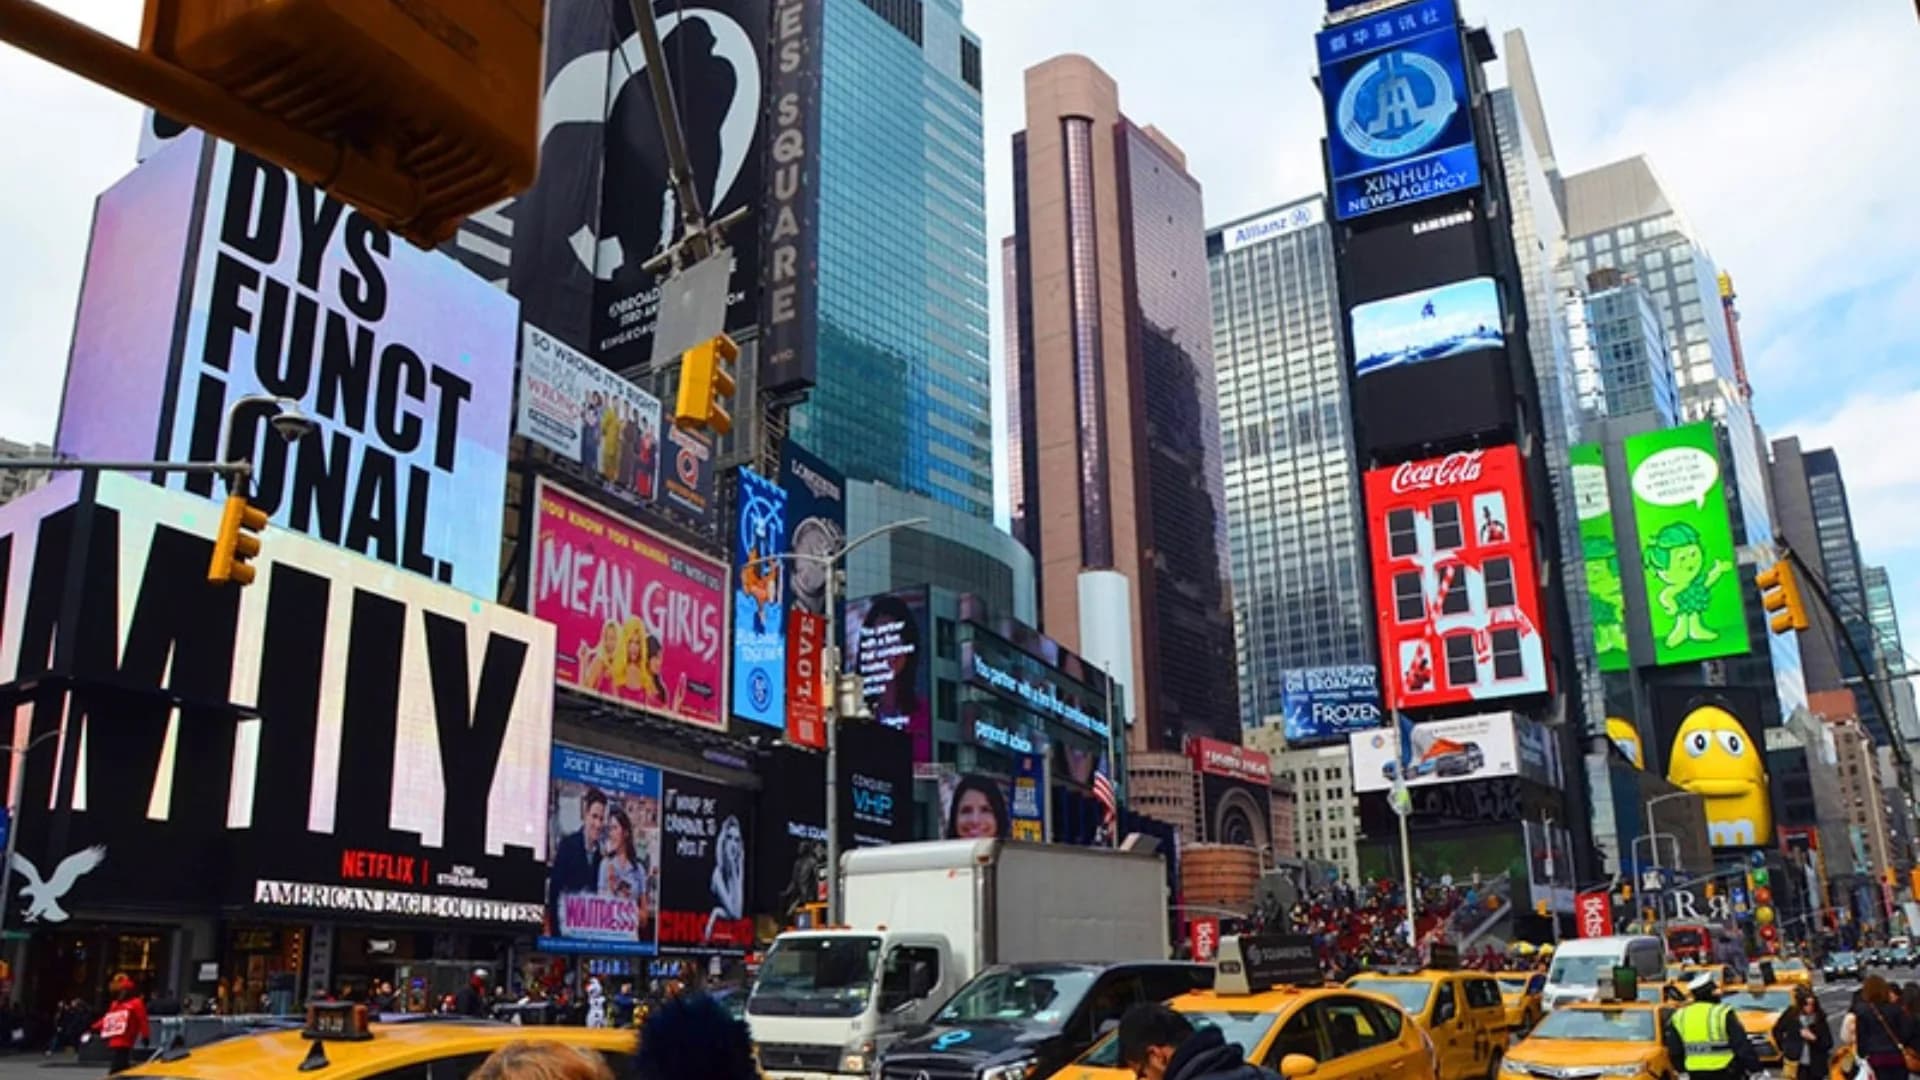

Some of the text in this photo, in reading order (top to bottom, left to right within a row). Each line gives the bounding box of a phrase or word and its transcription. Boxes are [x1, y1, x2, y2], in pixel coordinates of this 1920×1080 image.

[1348, 171, 1468, 213] NEWS AGENCY
[1364, 160, 1448, 195] XINHUA
[770, 94, 805, 325] SQUARE
[1412, 211, 1473, 235] SAMSUNG
[221, 143, 392, 323] DYS
[1234, 216, 1288, 244] Allianz
[201, 251, 471, 473] FUNCT
[555, 344, 601, 383] WRONG
[539, 538, 719, 663] MEAN GIRLS
[1307, 676, 1374, 692] BROADWAY
[1311, 702, 1381, 726] FROZEN
[563, 755, 592, 774] JOEY
[342, 849, 413, 885] NETFLIX
[437, 872, 488, 890] STREAMING
[453, 864, 474, 876] NOW
[255, 880, 383, 912] AMERICAN
[385, 889, 438, 915] EAGLE
[565, 895, 635, 932] WAITRESS
